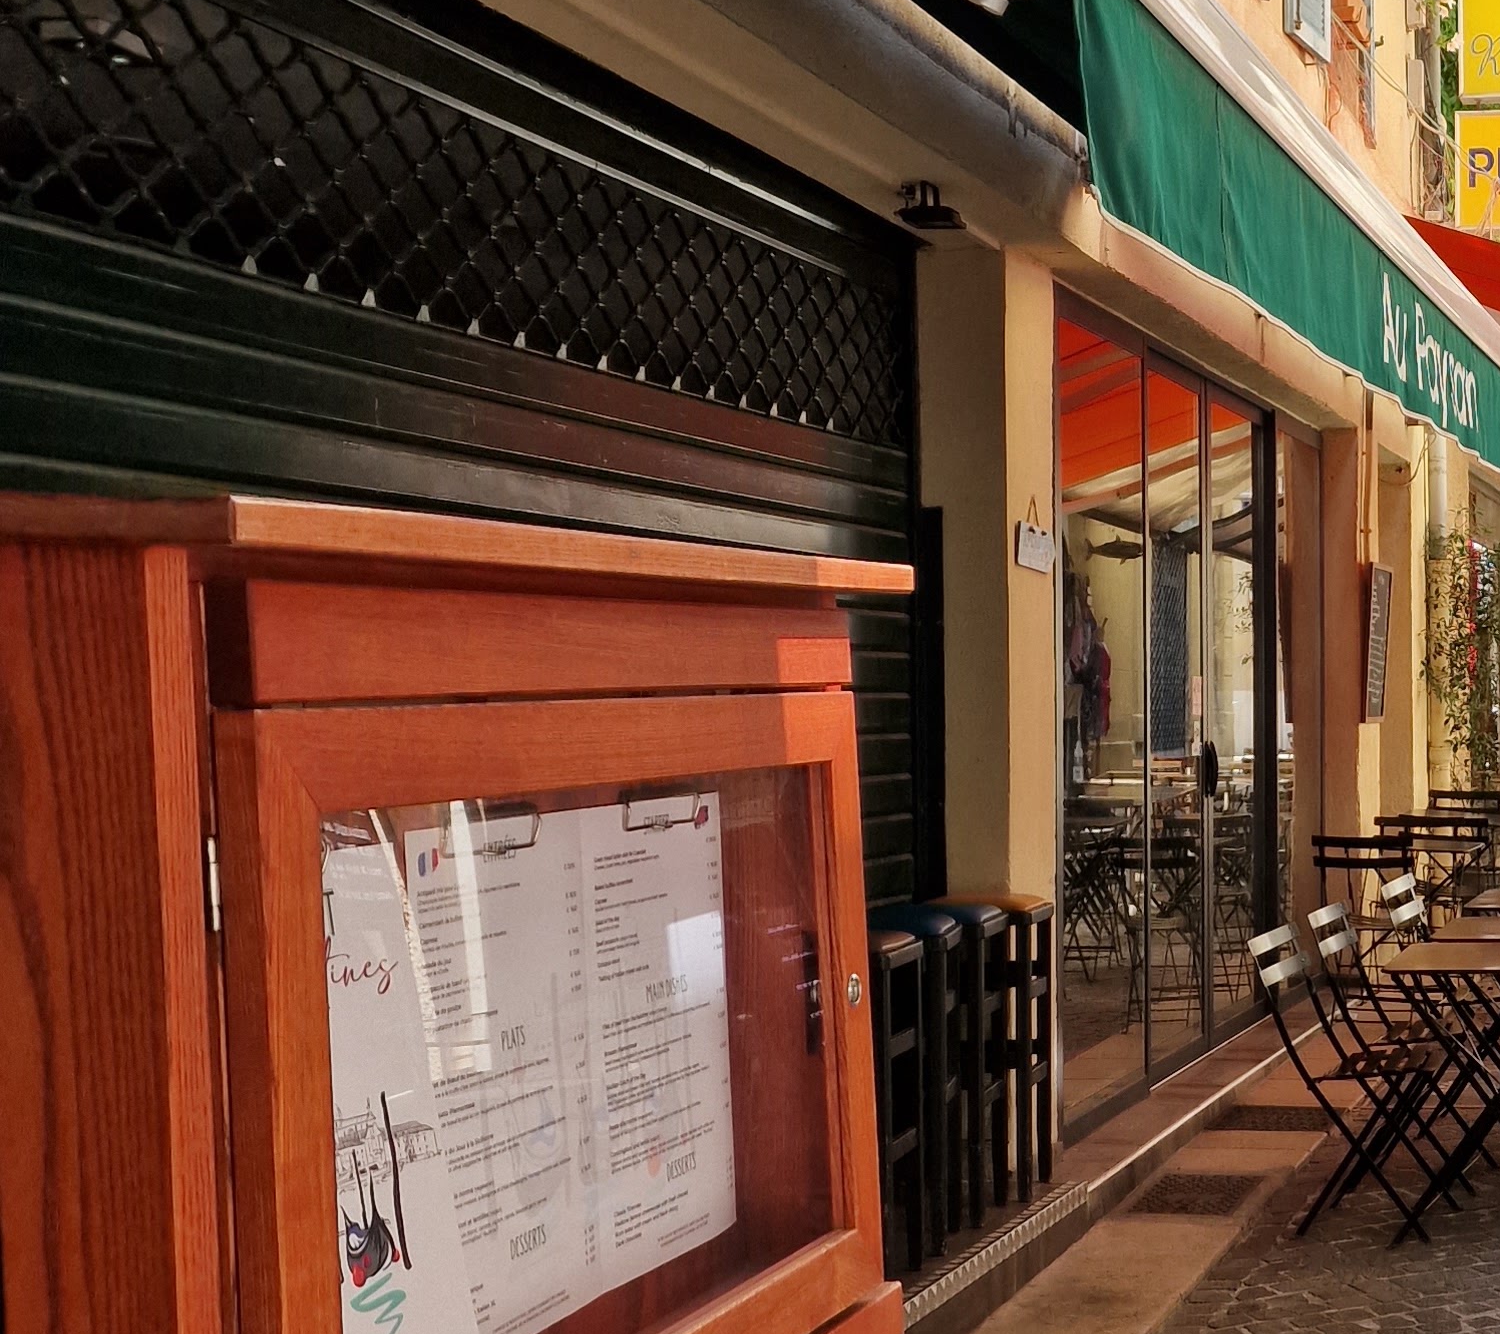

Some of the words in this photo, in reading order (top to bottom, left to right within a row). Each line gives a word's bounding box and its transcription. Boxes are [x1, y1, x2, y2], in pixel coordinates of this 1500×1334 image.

[500, 1025, 527, 1052] PLATS
[666, 1151, 698, 1183] DESSERTS
[509, 1223, 547, 1260] DESSERTS
